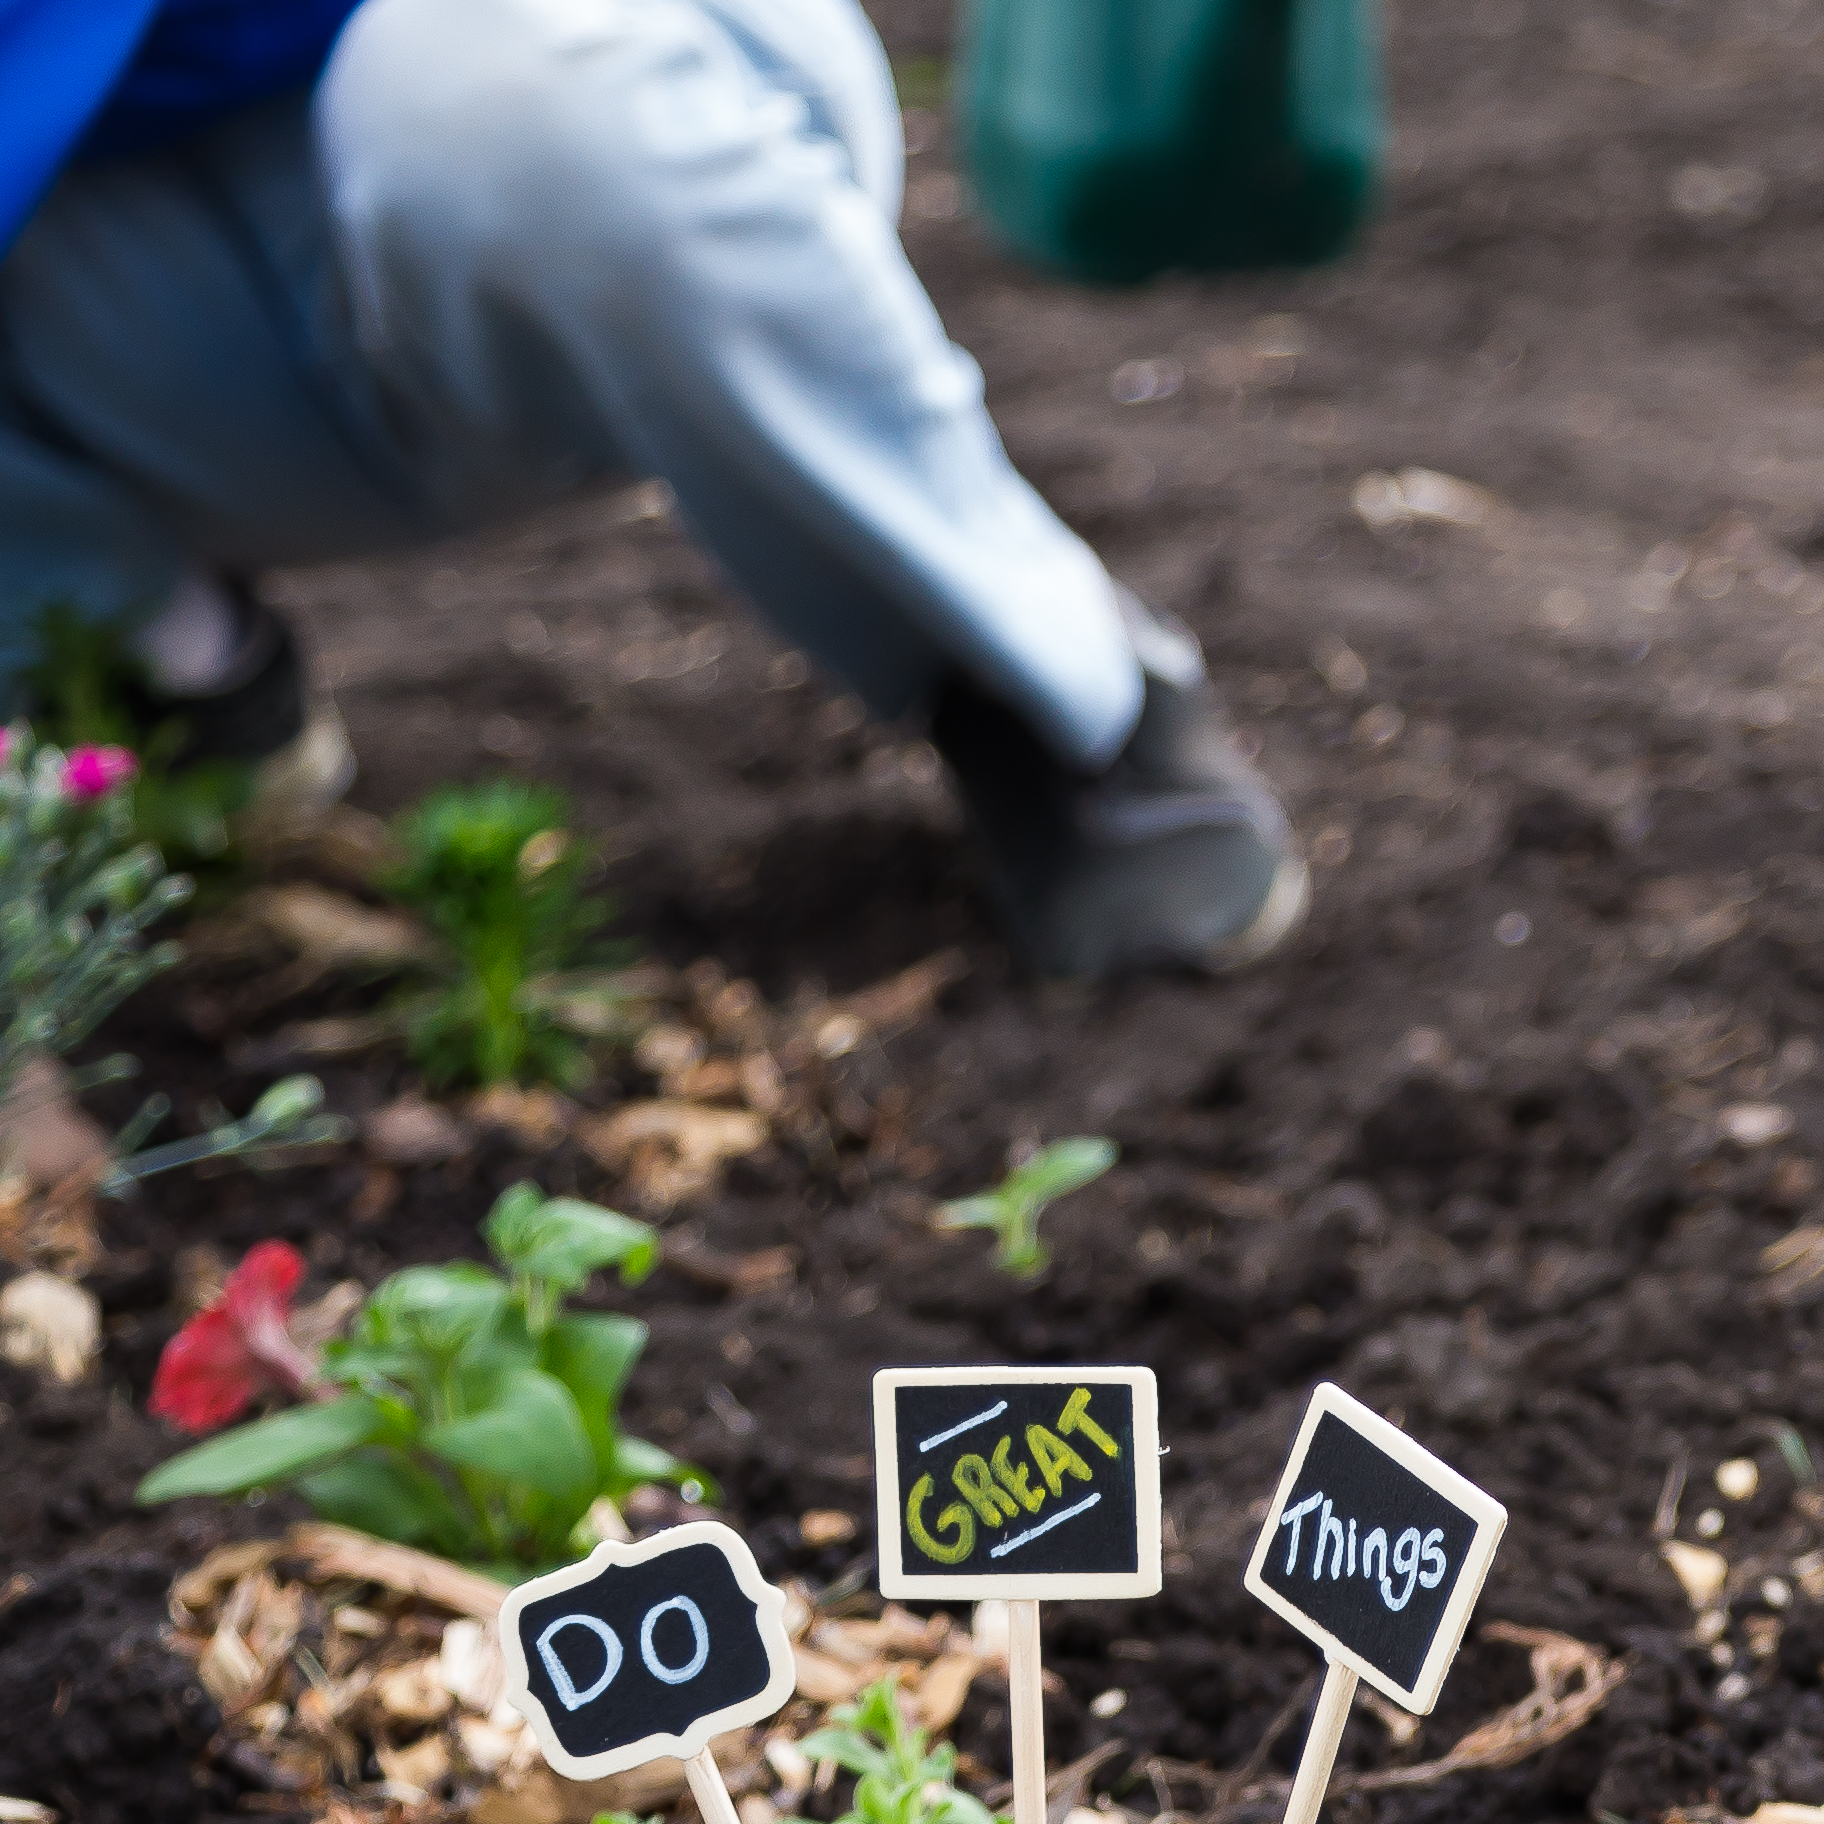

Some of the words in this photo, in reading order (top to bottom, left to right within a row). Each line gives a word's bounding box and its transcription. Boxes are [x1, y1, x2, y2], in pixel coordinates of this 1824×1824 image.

[906, 1386, 1120, 1565] GREAT
[1280, 1490, 1447, 1612] Things
[536, 1595, 710, 1712] DO
